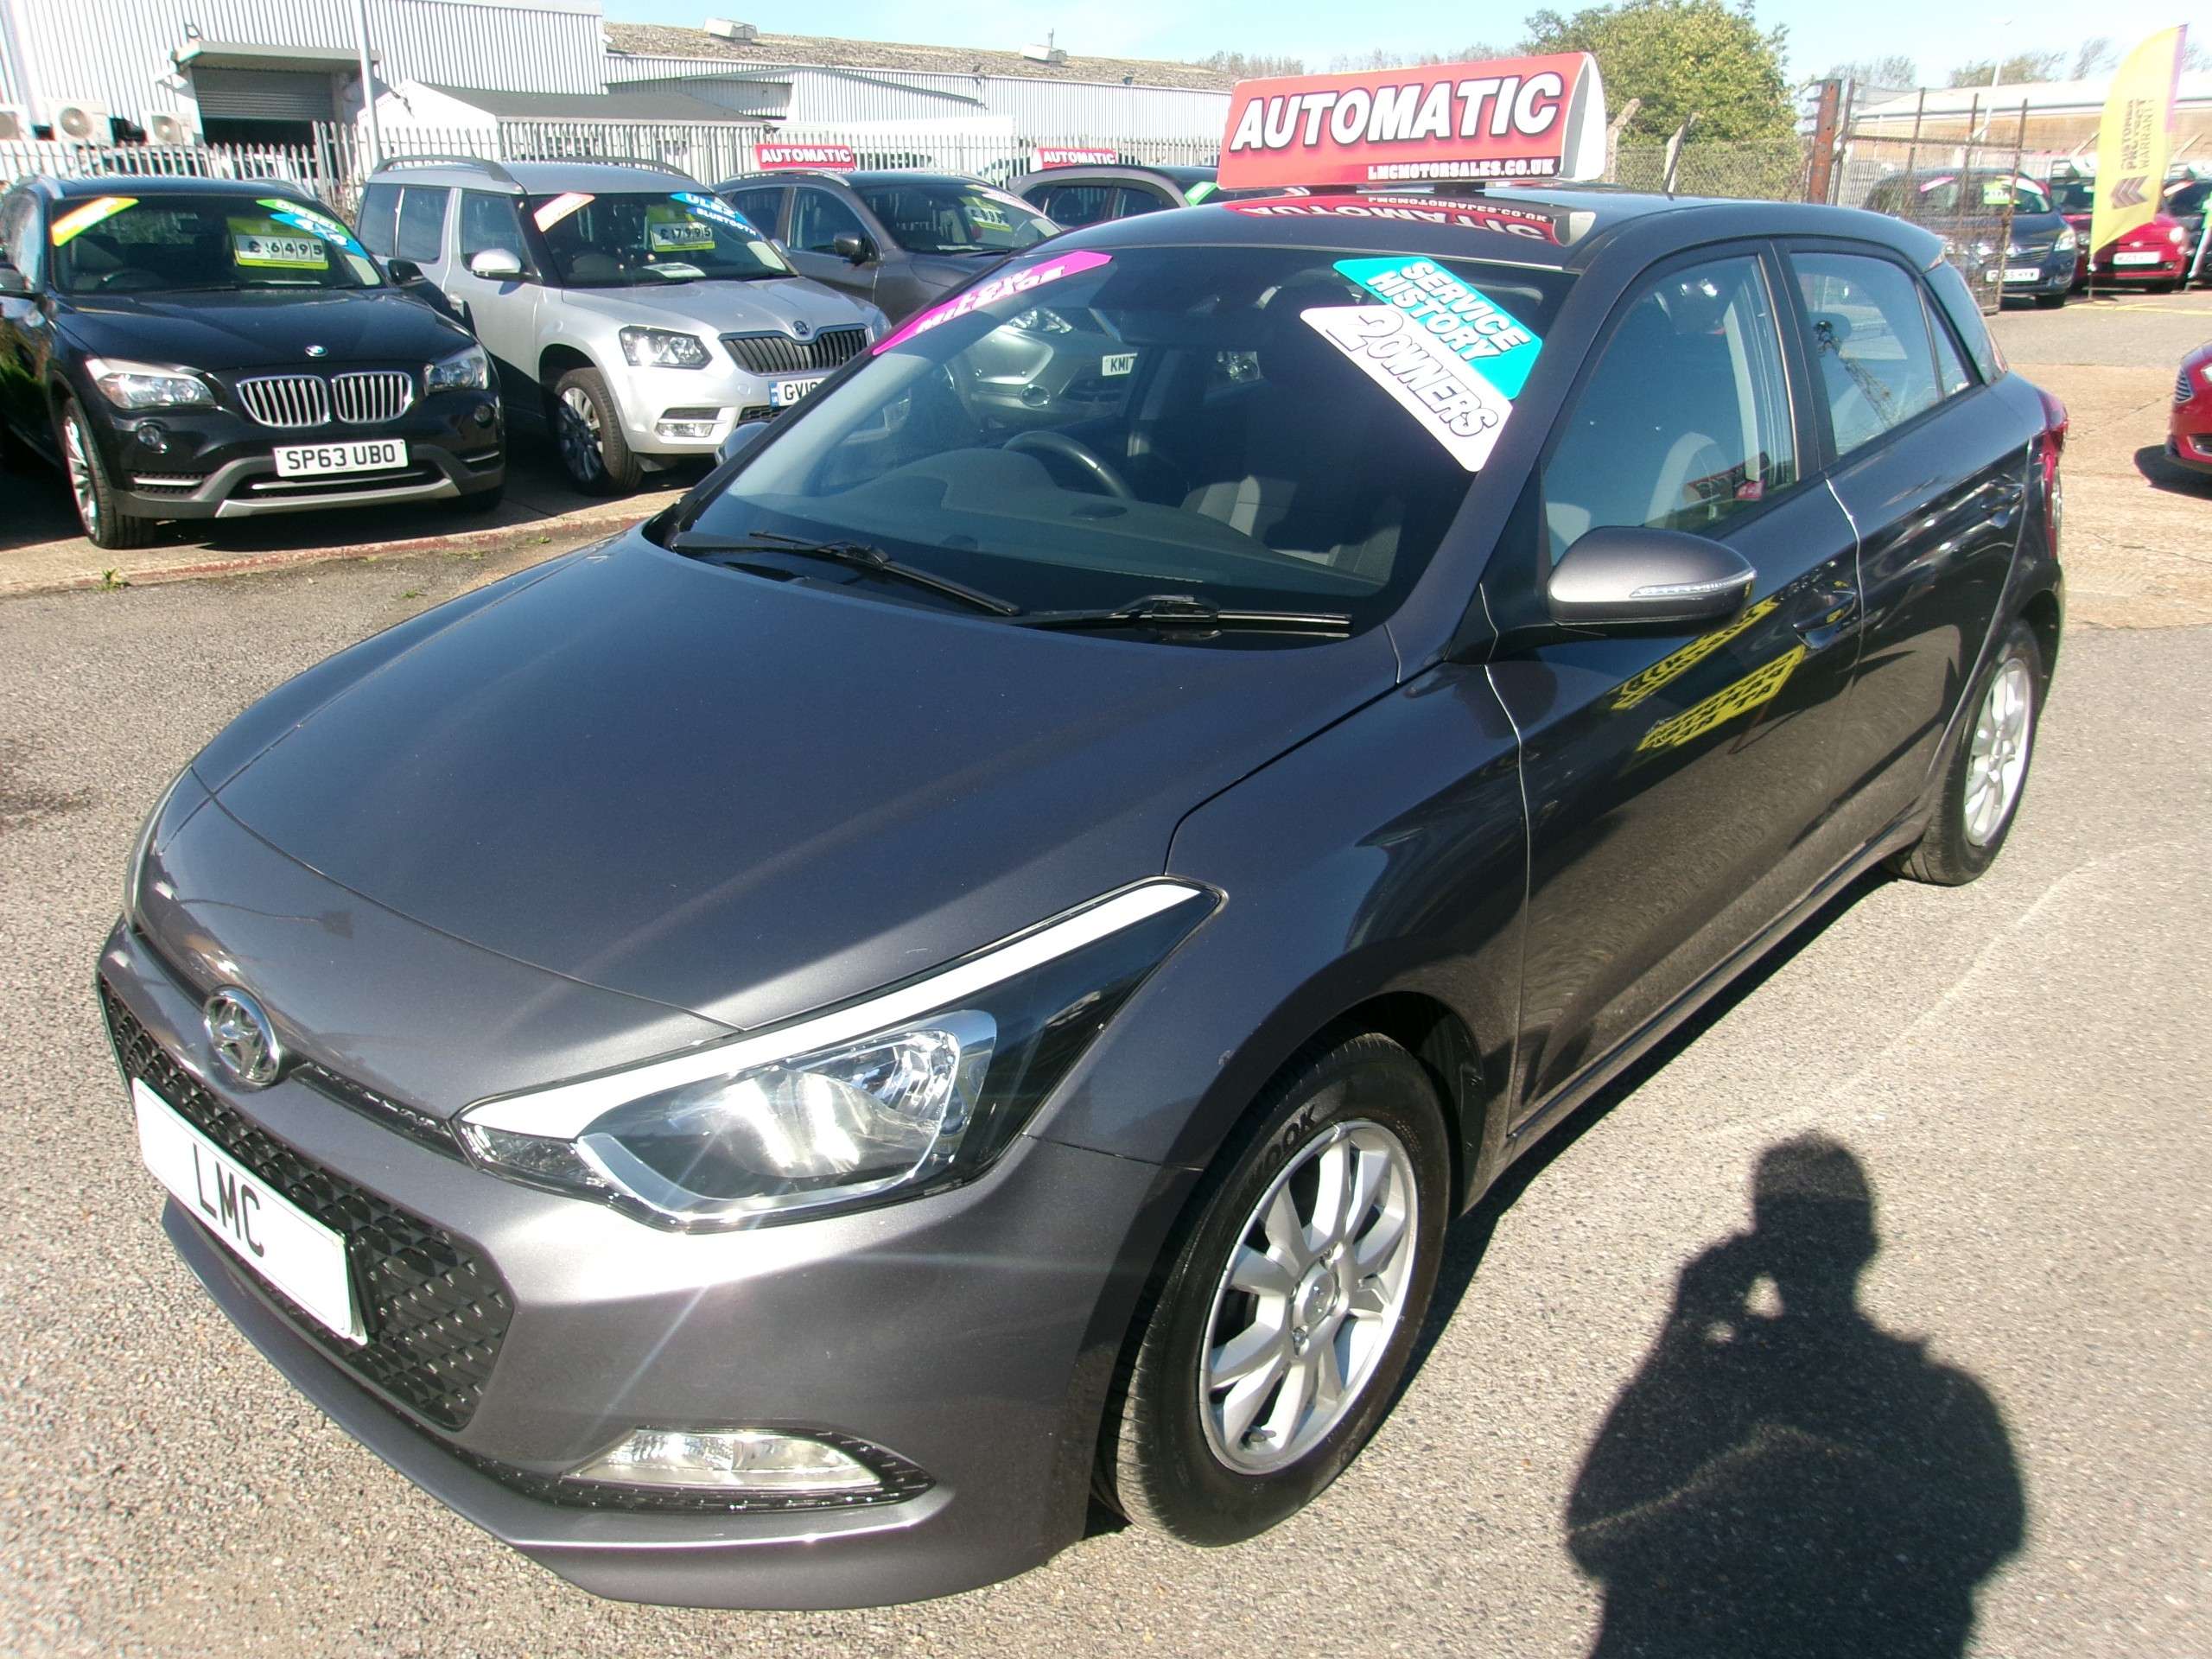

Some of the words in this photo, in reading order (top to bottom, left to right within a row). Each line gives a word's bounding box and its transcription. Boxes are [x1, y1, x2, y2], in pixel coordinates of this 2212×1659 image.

[1229, 71, 1563, 153] AUTOMATIC
[761, 148, 852, 162] AUTOMATIC
[1043, 150, 1116, 165] AUTOMATIC
[1367, 158, 1556, 181] LMCMOTORSALES.CO.UK
[696, 207, 757, 236] BLUETOOTH
[1365, 270, 1502, 362] HISTORY
[1400, 261, 1532, 353] SERVICE
[1110, 356, 1135, 372] KM1
[1325, 308, 1404, 352] 2
[1366, 334, 1499, 437] OWNERS
[286, 447, 347, 470] SP63
[353, 443, 397, 466] UBO
[193, 1142, 265, 1258] LMC
